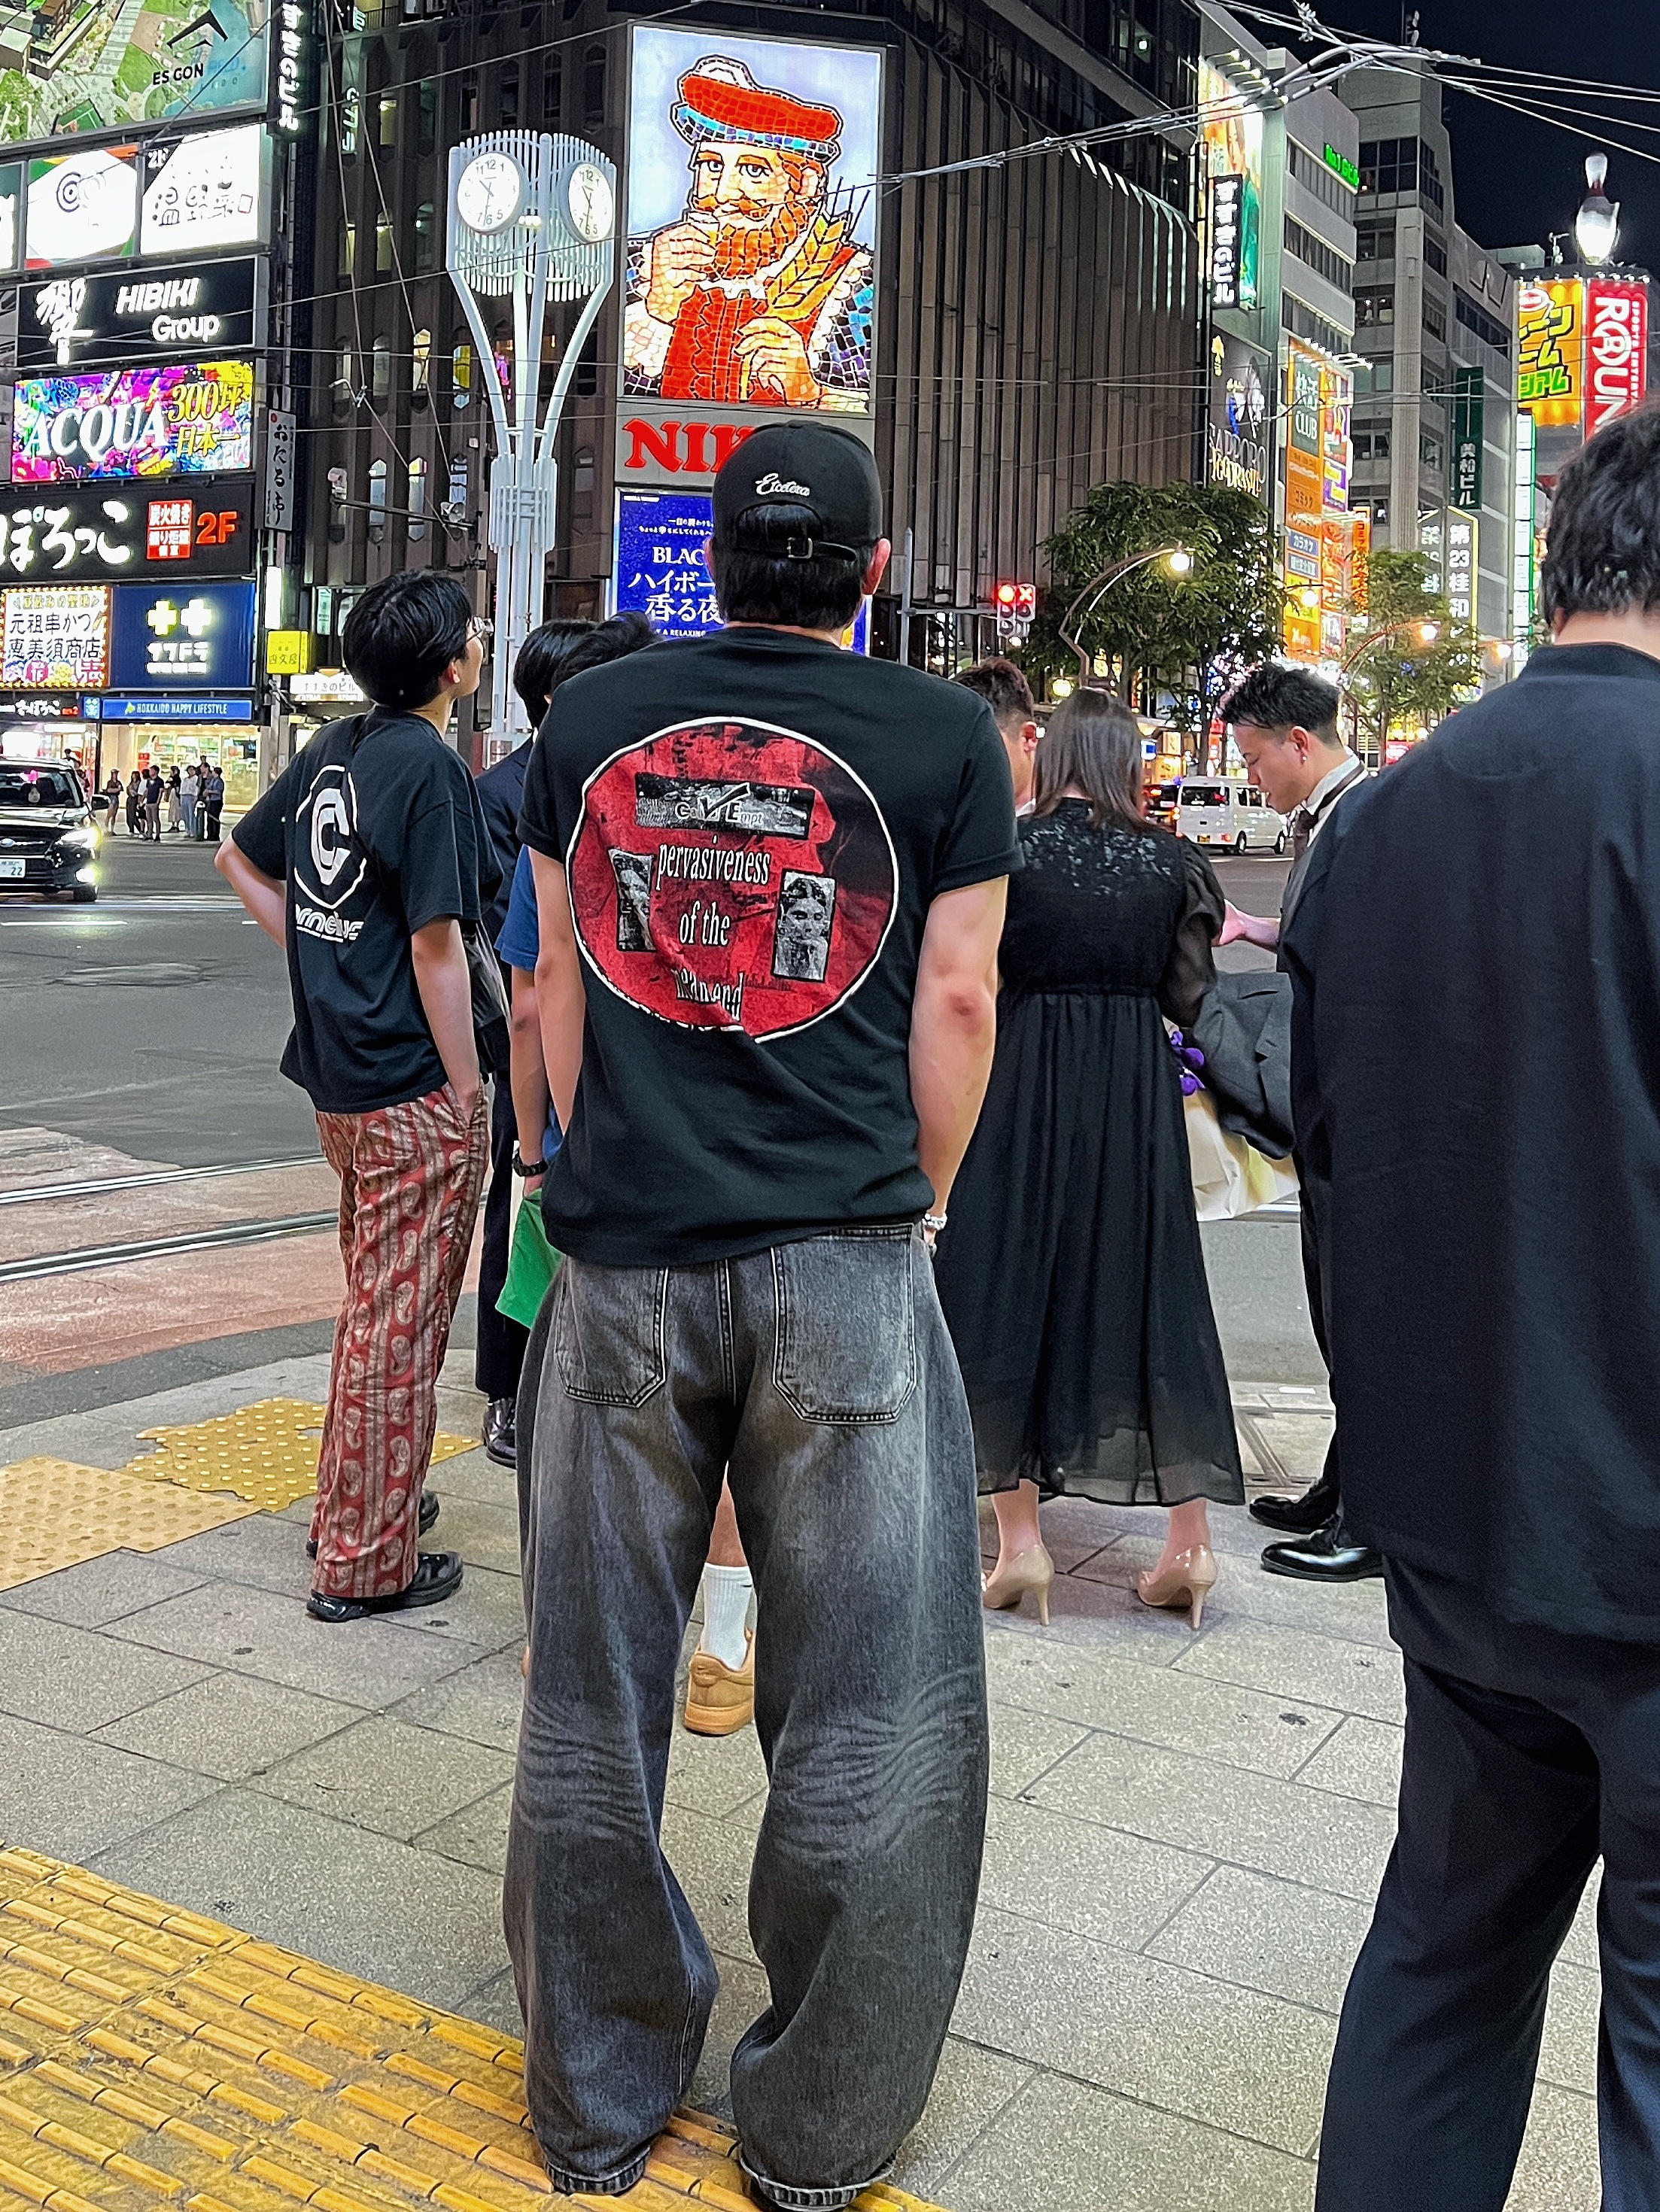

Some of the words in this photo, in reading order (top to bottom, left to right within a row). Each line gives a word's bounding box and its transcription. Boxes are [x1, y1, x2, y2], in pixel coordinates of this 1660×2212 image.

[153, 70, 169, 85] ES
[173, 63, 204, 82] CON
[115, 277, 200, 314] HIBIKI
[151, 314, 220, 342] Group
[168, 381, 243, 422] 300坪
[23, 401, 168, 461] ACQUA
[176, 421, 241, 458] 日本一
[1295, 410, 1318, 441] CLUB
[195, 510, 237, 544] 2F
[652, 546, 705, 566] BLAC
[9, 612, 91, 634] 元祖串かつ
[644, 592, 725, 624] 香る夜
[8, 636, 101, 659] 恵美須商店
[136, 703, 170, 714] HOKKAIDO
[171, 703, 193, 714] HAPPY
[193, 703, 228, 714] LIFESTYLE
[655, 834, 771, 891] pervasiveness
[680, 900, 701, 943] of
[701, 901, 730, 946] the
